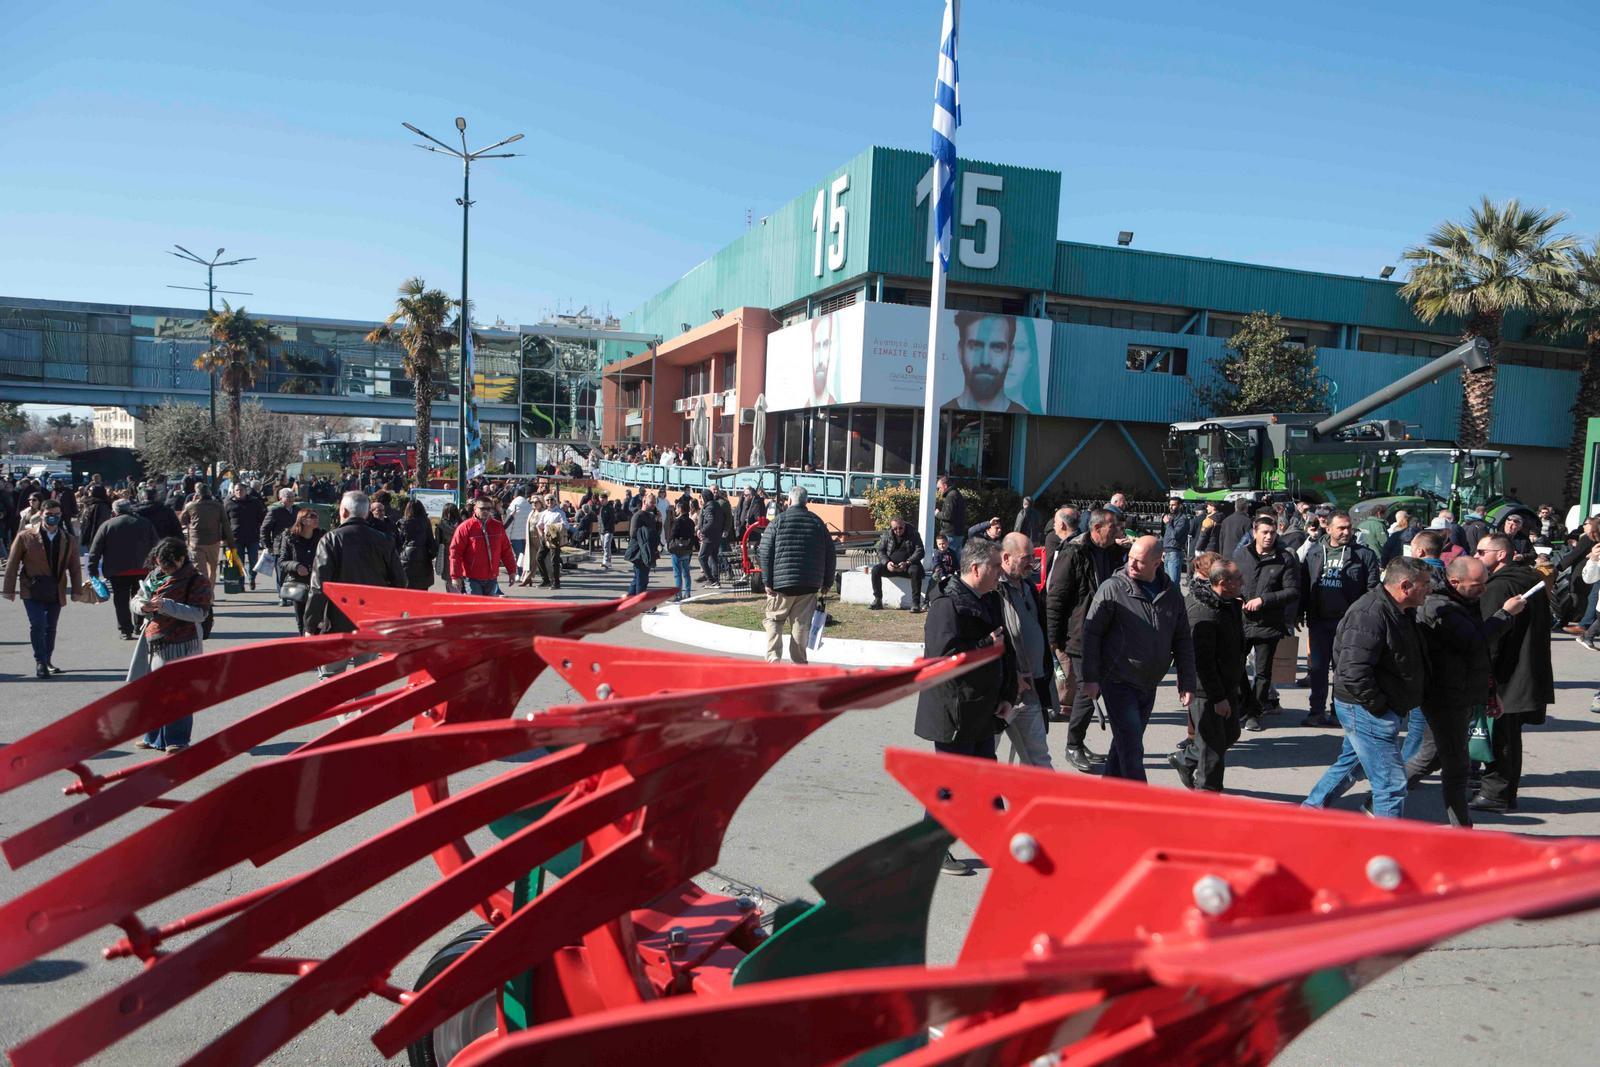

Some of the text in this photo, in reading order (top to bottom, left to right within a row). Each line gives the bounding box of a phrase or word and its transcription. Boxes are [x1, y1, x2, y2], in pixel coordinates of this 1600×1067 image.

[812, 174, 850, 277] 15
[916, 167, 1003, 269] 15
[1325, 467, 1360, 481] FENDT
